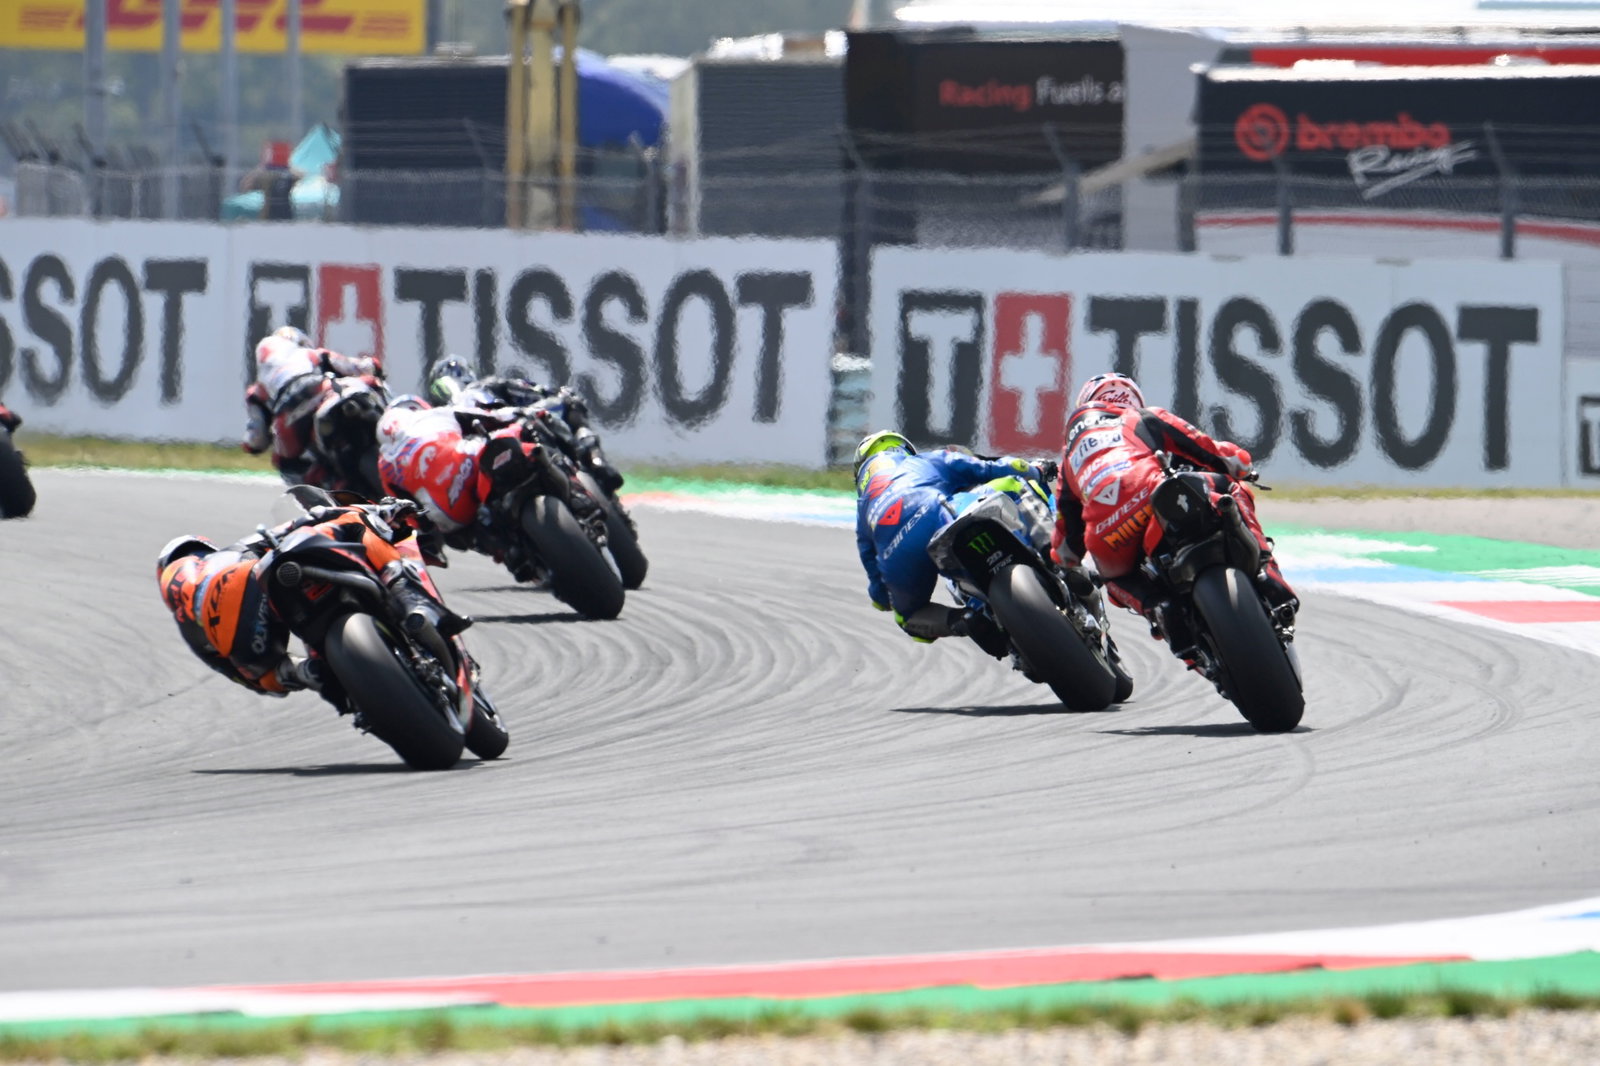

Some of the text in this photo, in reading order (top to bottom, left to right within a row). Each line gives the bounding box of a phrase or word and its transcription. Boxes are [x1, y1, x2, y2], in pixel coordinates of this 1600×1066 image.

[939, 78, 1032, 111] Racing
[1296, 112, 1451, 149] brembo
[0, 253, 207, 406] SOT
[394, 264, 812, 428] TISSOT
[1085, 297, 1539, 471] TISSOT
